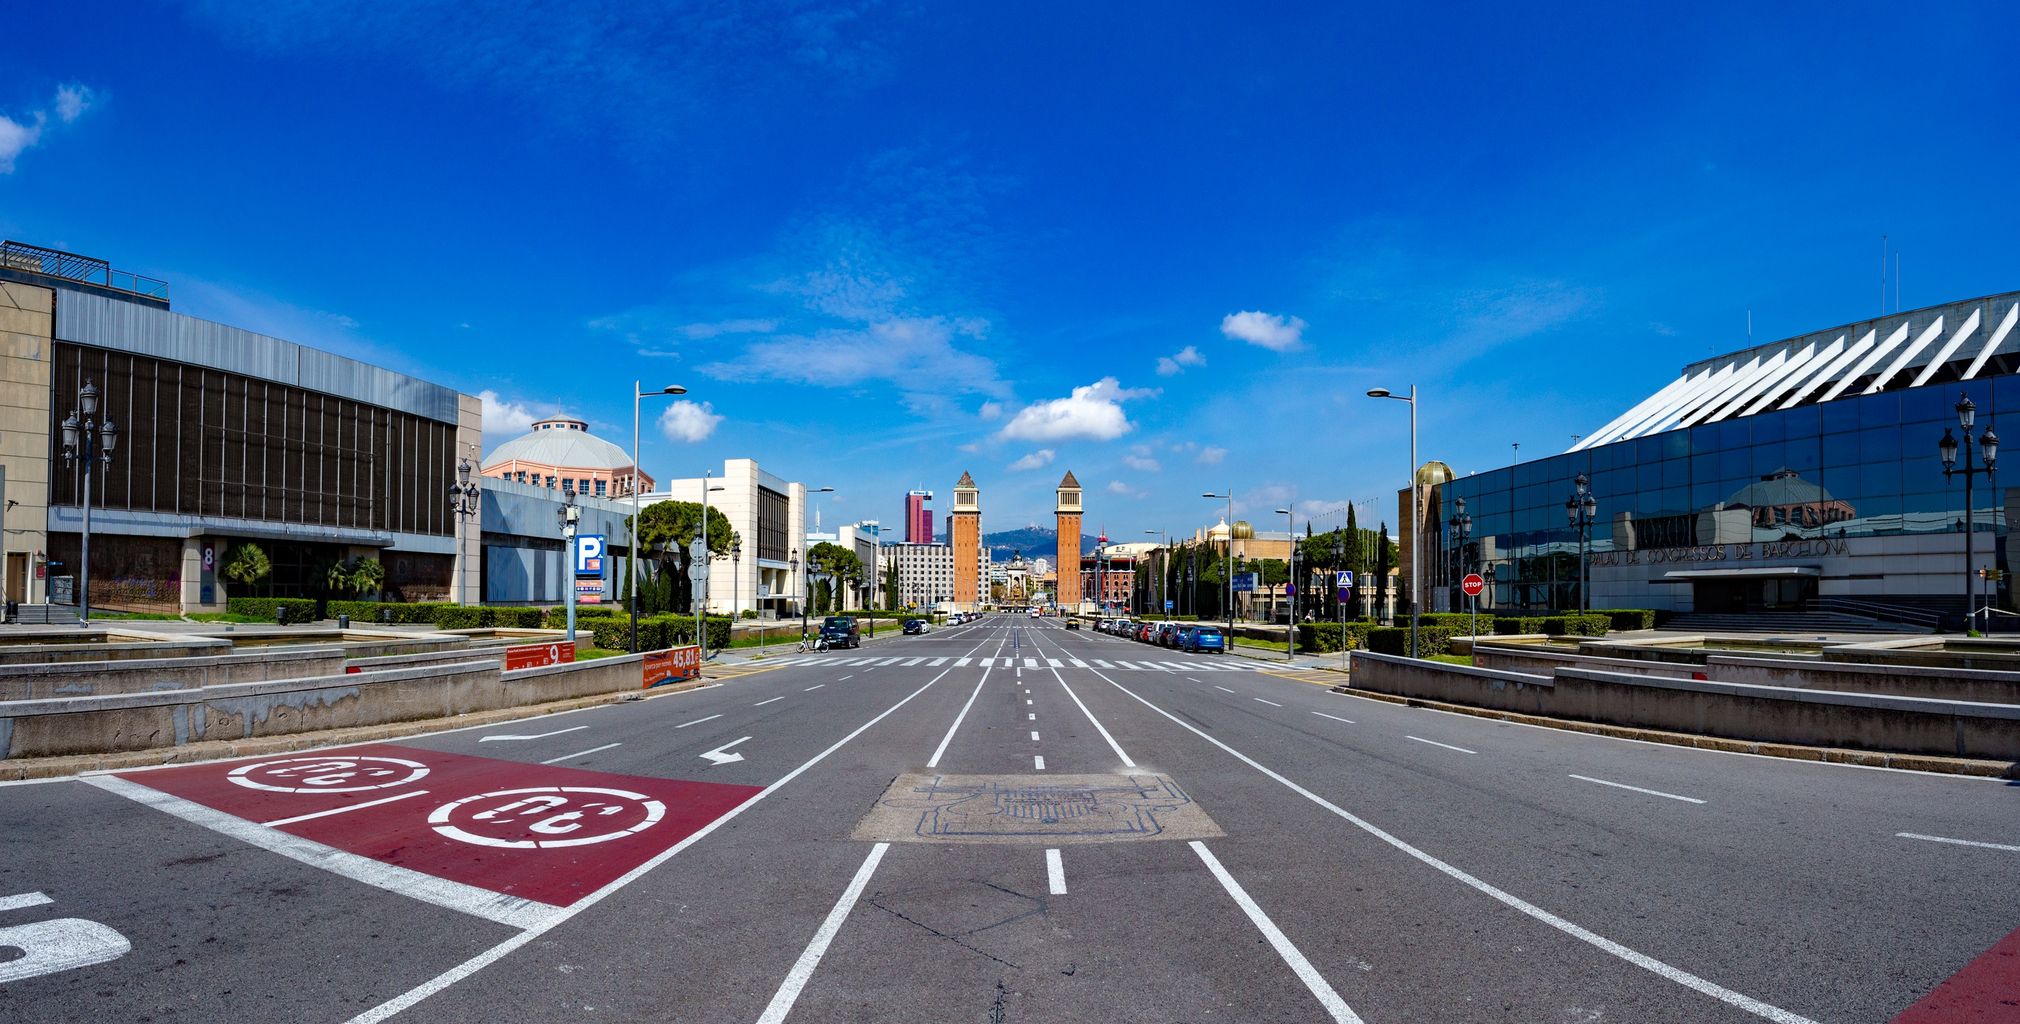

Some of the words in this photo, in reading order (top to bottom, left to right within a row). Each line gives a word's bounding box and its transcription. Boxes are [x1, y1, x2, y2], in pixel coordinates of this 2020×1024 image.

[205, 548, 213, 565] 8
[579, 537, 600, 570] P
[1590, 553, 1619, 566] PALAU
[1626, 551, 1640, 565] DE
[1647, 545, 1726, 563] CONGRESSOS
[1734, 544, 1753, 559] DE
[1763, 538, 1851, 558] BARCELONA
